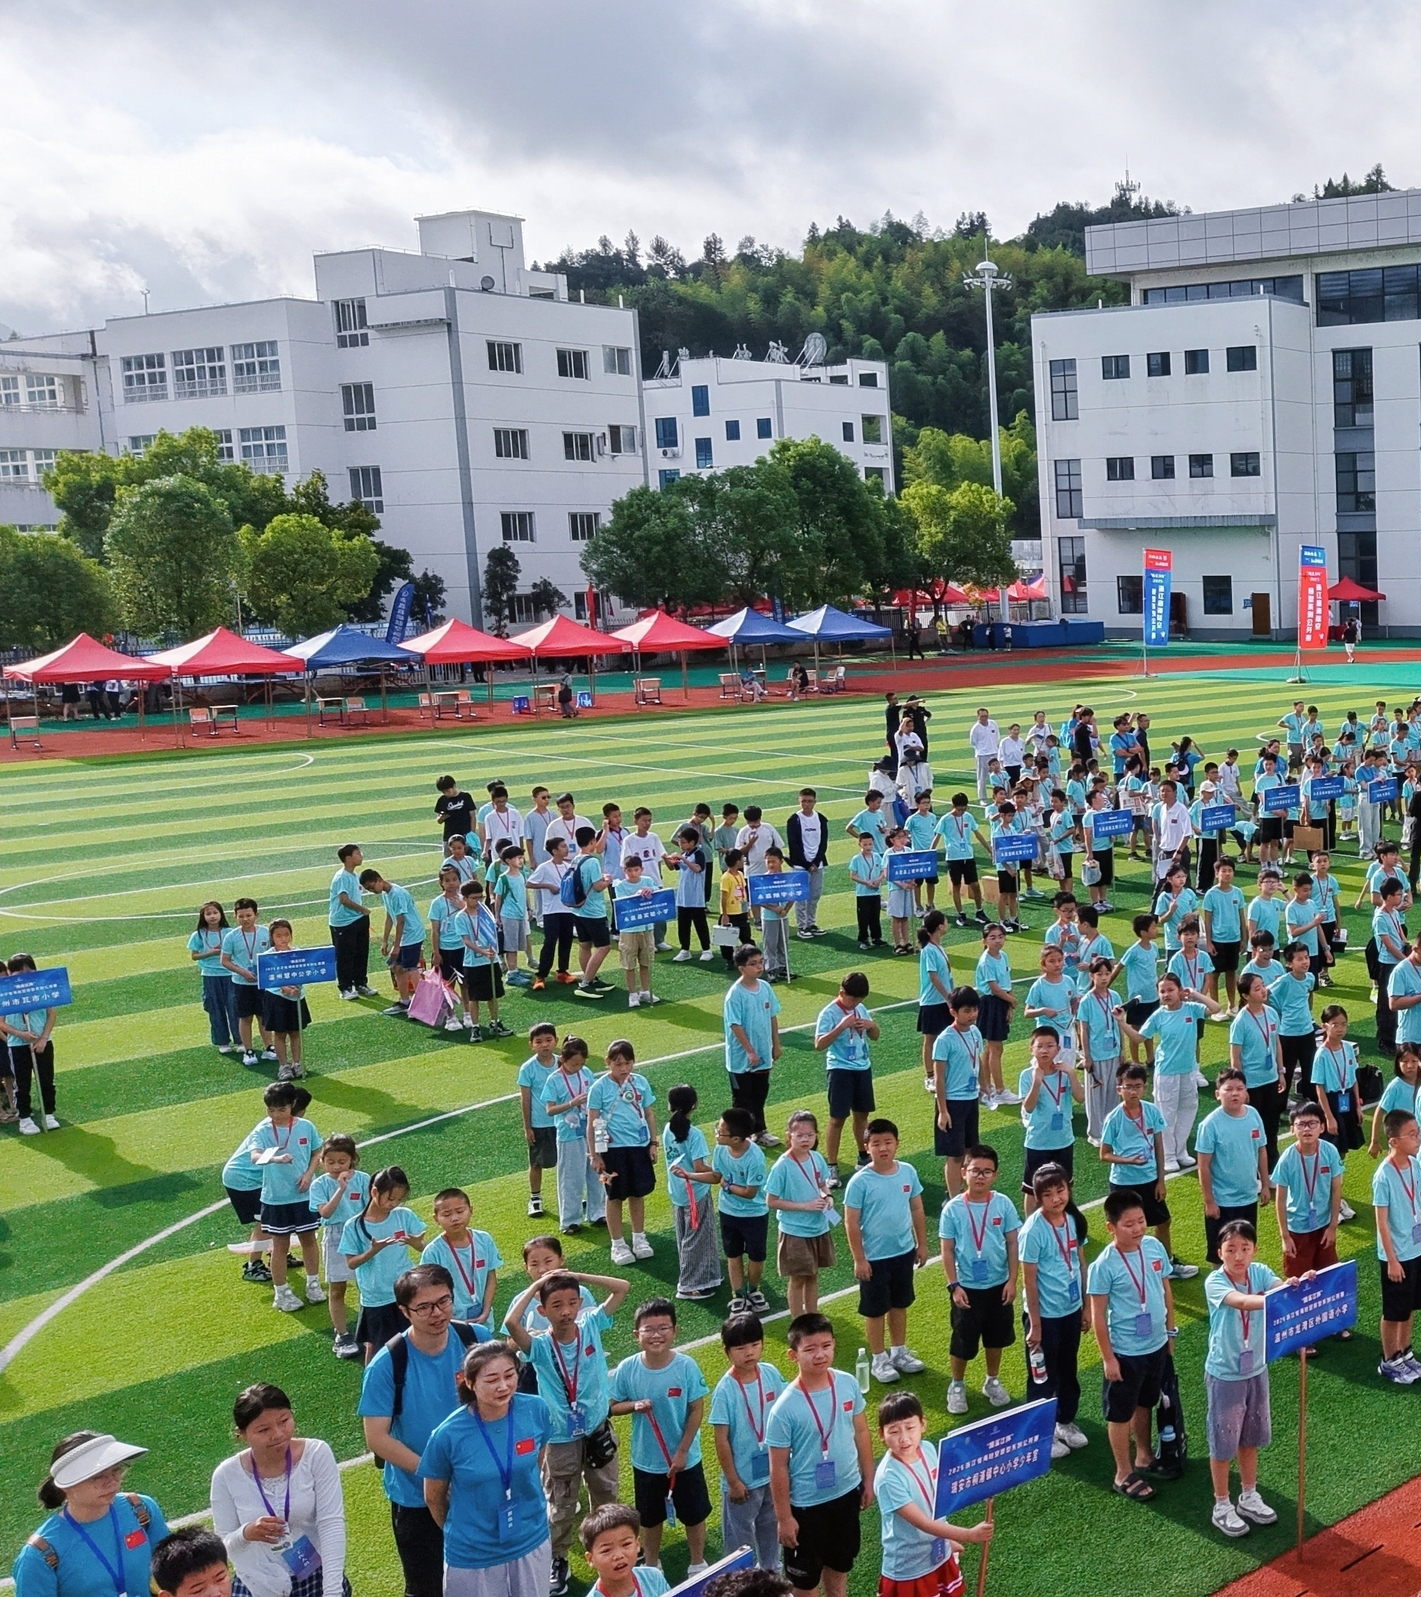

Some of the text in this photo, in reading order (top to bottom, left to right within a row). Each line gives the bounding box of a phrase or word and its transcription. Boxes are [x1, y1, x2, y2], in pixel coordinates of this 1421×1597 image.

[1274, 1304, 1348, 1344] 温州市龙湾区外国语小学
